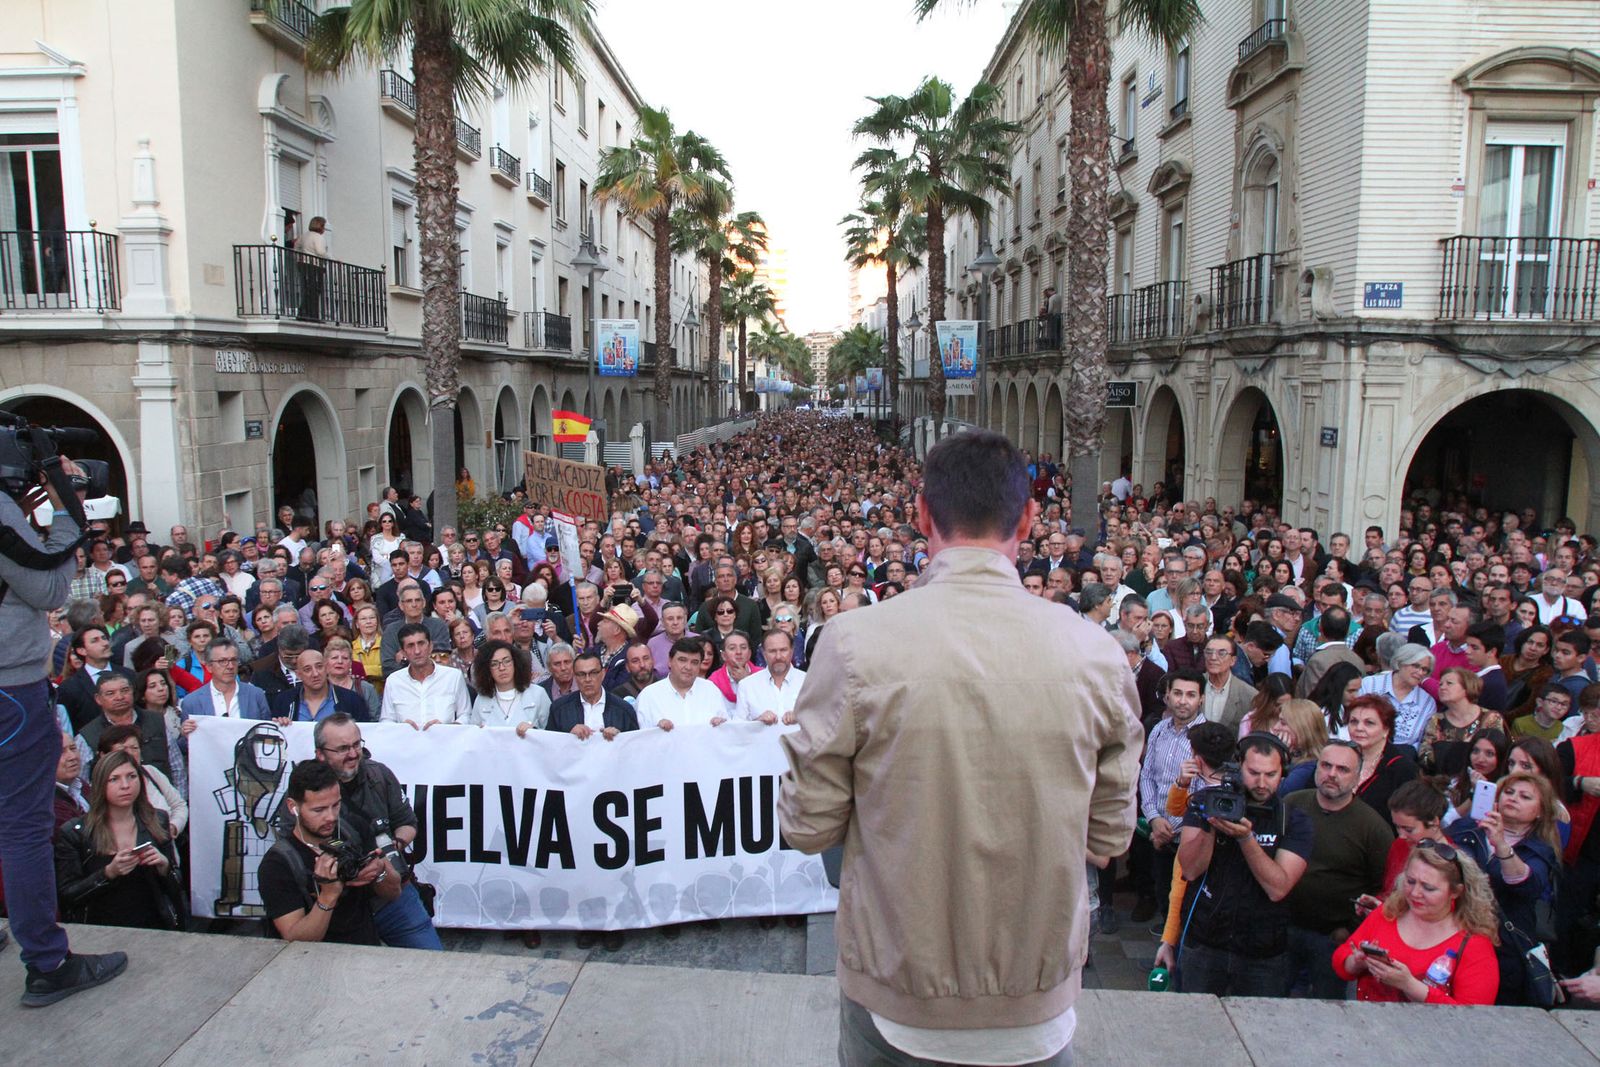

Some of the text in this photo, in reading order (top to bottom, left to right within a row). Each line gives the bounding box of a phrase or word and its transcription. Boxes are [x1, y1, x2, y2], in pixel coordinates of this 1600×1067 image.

[1365, 299, 1377, 307] LAS
[216, 351, 251, 361] AVENIDA
[525, 452, 602, 492] HUELVA CADIZ
[528, 480, 606, 520] POR LA COSTA
[400, 784, 576, 869] UELVA
[593, 784, 665, 870] SE
